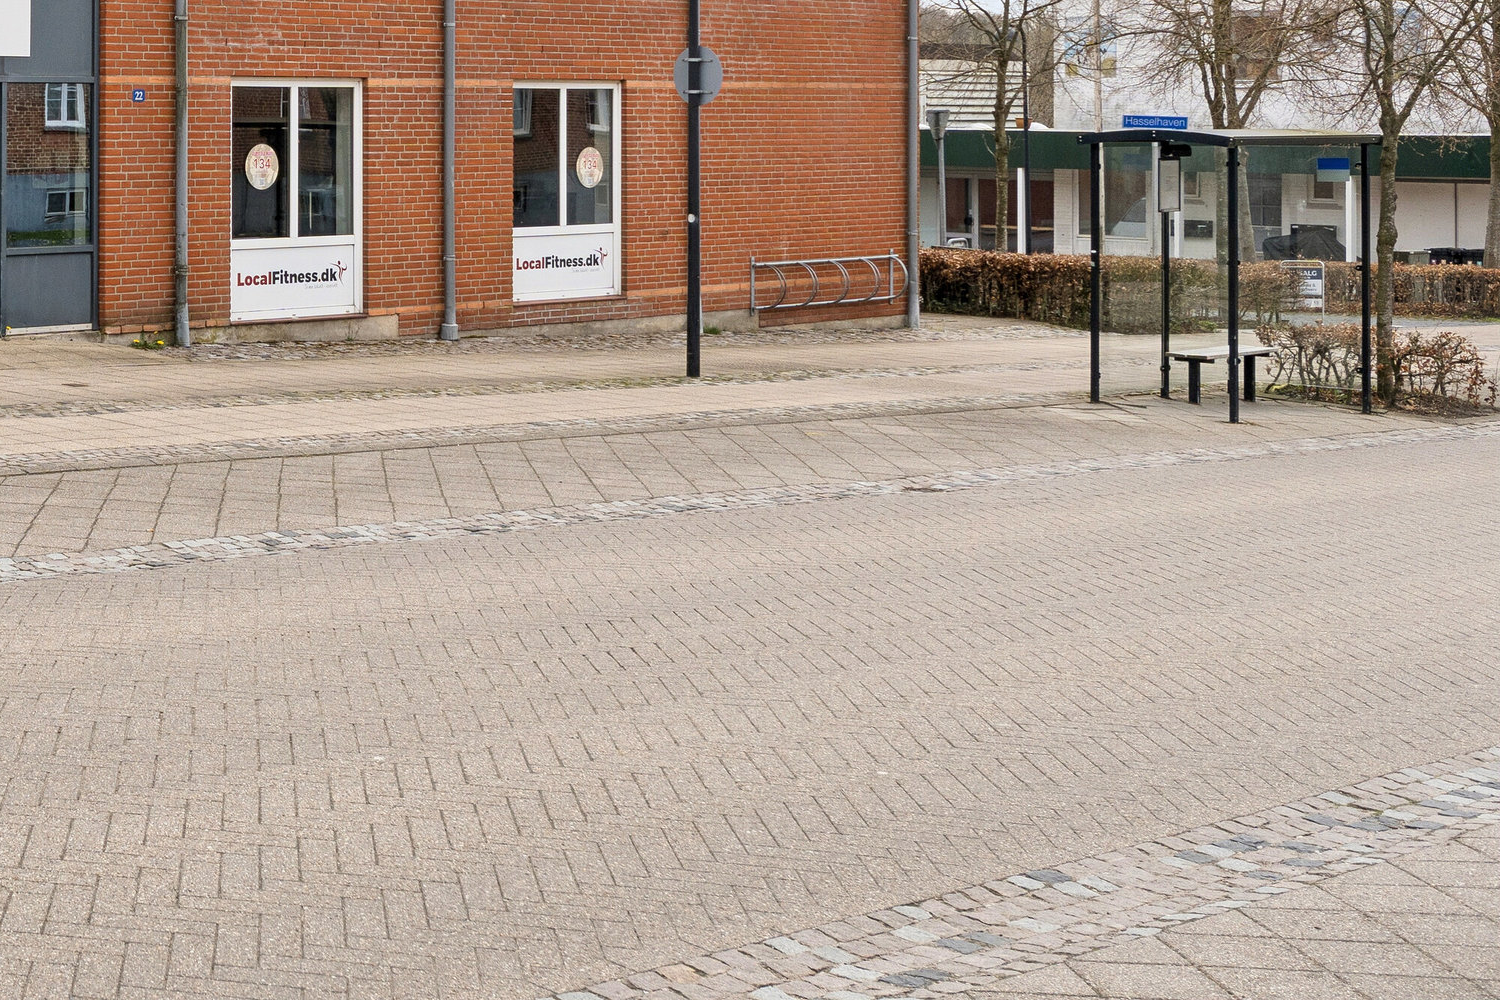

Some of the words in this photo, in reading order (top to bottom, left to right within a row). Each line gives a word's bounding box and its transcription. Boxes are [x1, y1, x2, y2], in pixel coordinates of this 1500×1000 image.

[134, 91, 143, 101] 22
[1125, 116, 1186, 127] Hasselhaven
[253, 158, 271, 169] 134
[583, 160, 597, 169] 134
[516, 254, 600, 270] LocalFitness.dk
[237, 268, 338, 287] LocalFitness.dk
